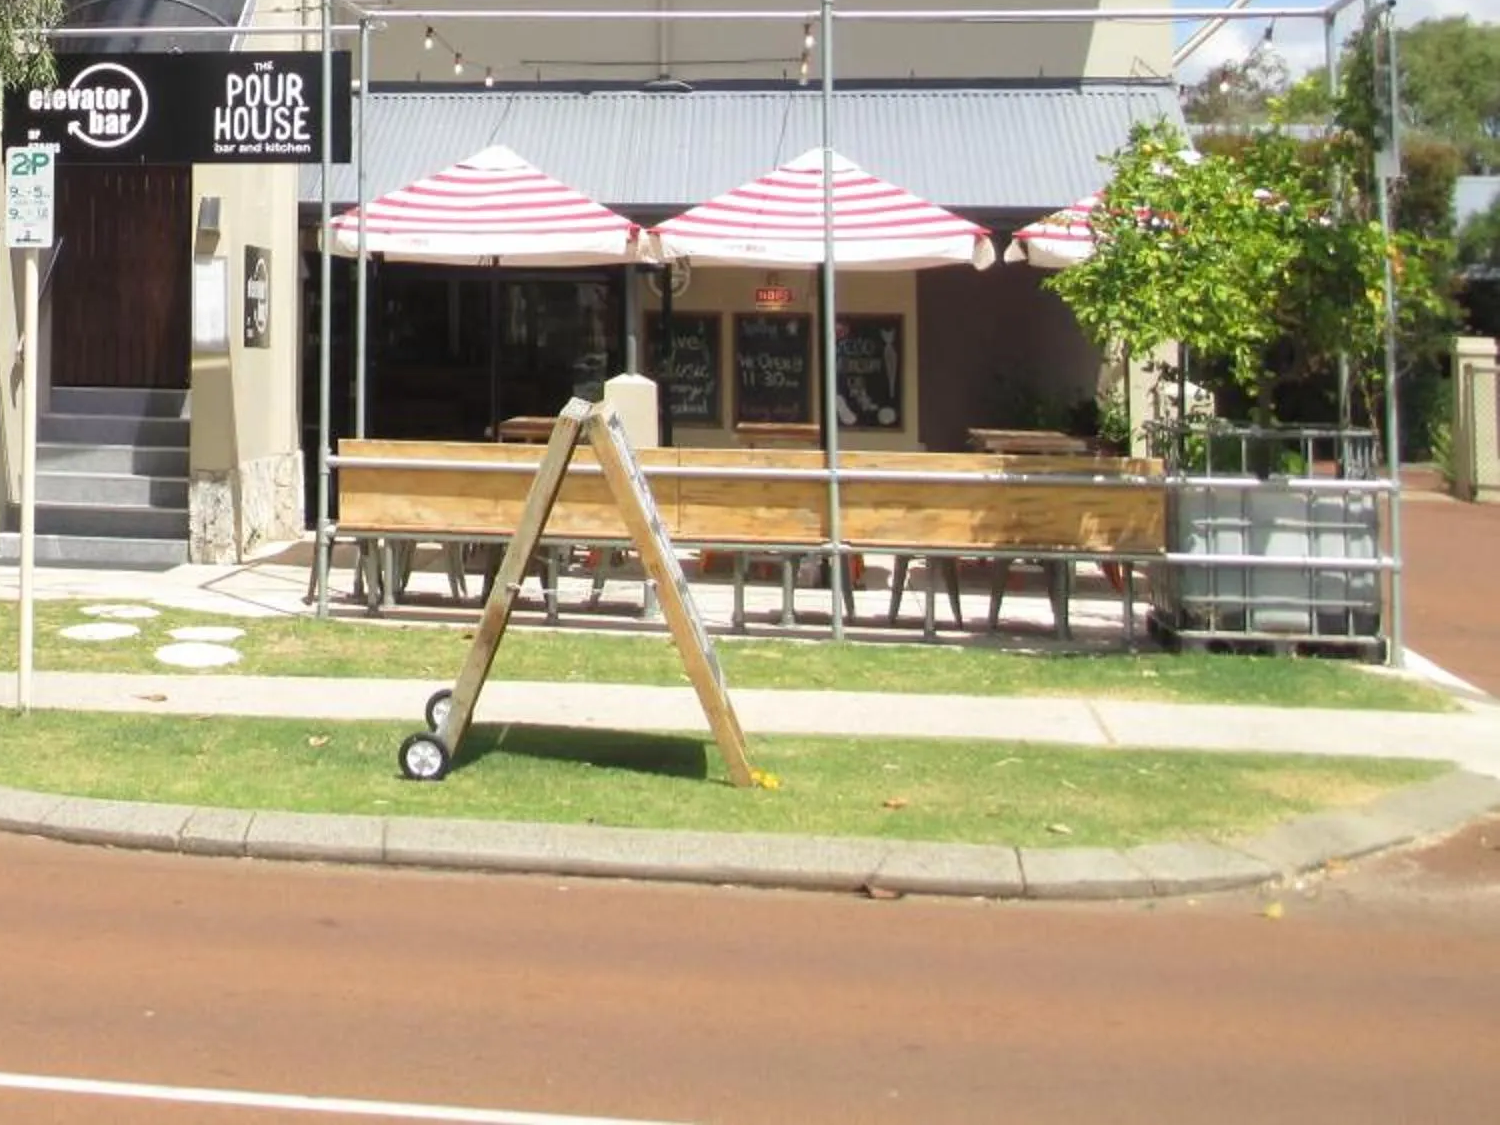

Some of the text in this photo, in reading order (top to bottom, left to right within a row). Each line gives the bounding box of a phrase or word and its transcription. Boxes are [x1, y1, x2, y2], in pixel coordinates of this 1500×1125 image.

[253, 60, 274, 72] THE
[28, 87, 132, 111] elevator
[226, 73, 304, 107] POUR
[88, 110, 132, 136] bar
[214, 106, 311, 141] HOUSE
[214, 142, 311, 154] bar and kitchen
[11, 152, 50, 176] 2P
